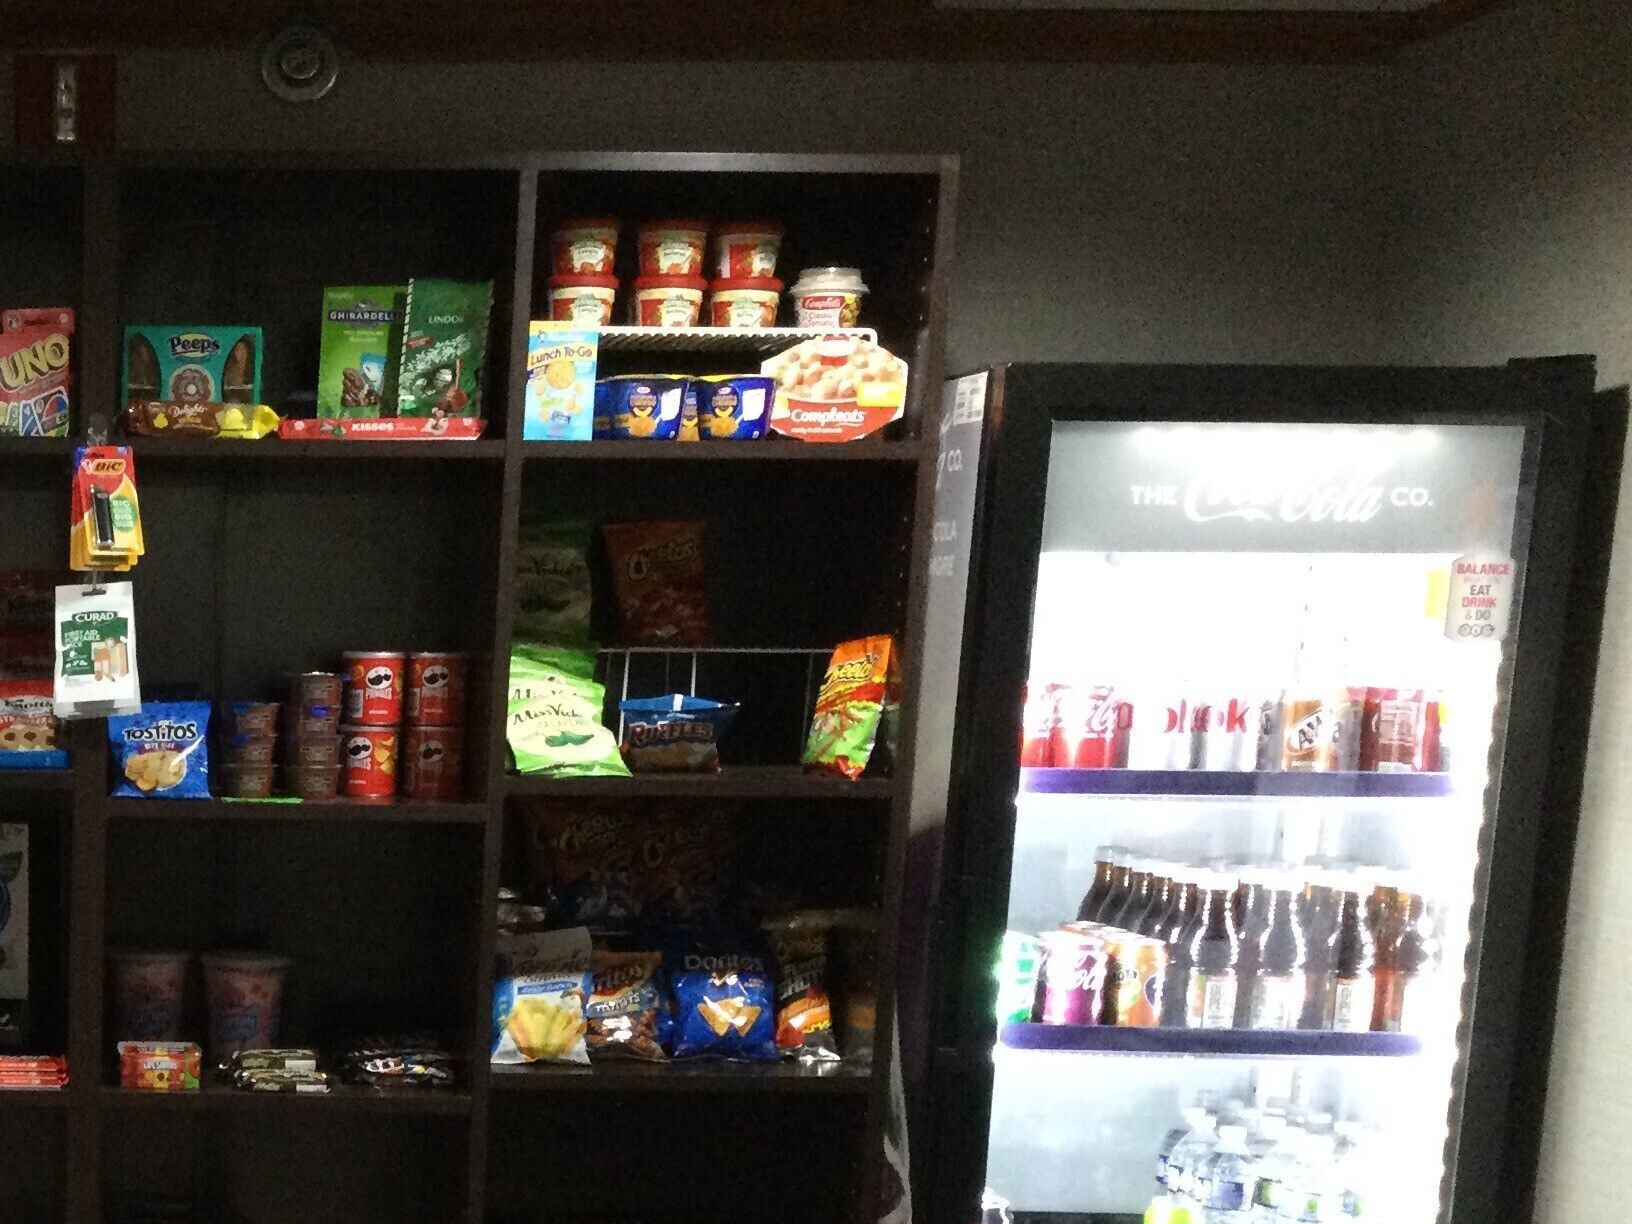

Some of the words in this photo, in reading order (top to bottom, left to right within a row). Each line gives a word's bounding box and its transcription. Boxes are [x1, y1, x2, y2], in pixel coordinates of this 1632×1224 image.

[169, 336, 220, 356] Peeps
[530, 348, 562, 365] Lunch
[789, 407, 866, 426] Compleats
[351, 422, 395, 433] KISSES
[1131, 485, 1179, 505] THE
[1184, 464, 1385, 522] Coca-Cola
[1390, 486, 1436, 507] CO.
[1455, 563, 1511, 576] BALANCE
[1469, 584, 1493, 596] EAT
[1461, 597, 1498, 608] DRINK
[74, 612, 116, 623] CURAD
[125, 720, 197, 741] TOSTITOS
[685, 954, 765, 972] Doritos
